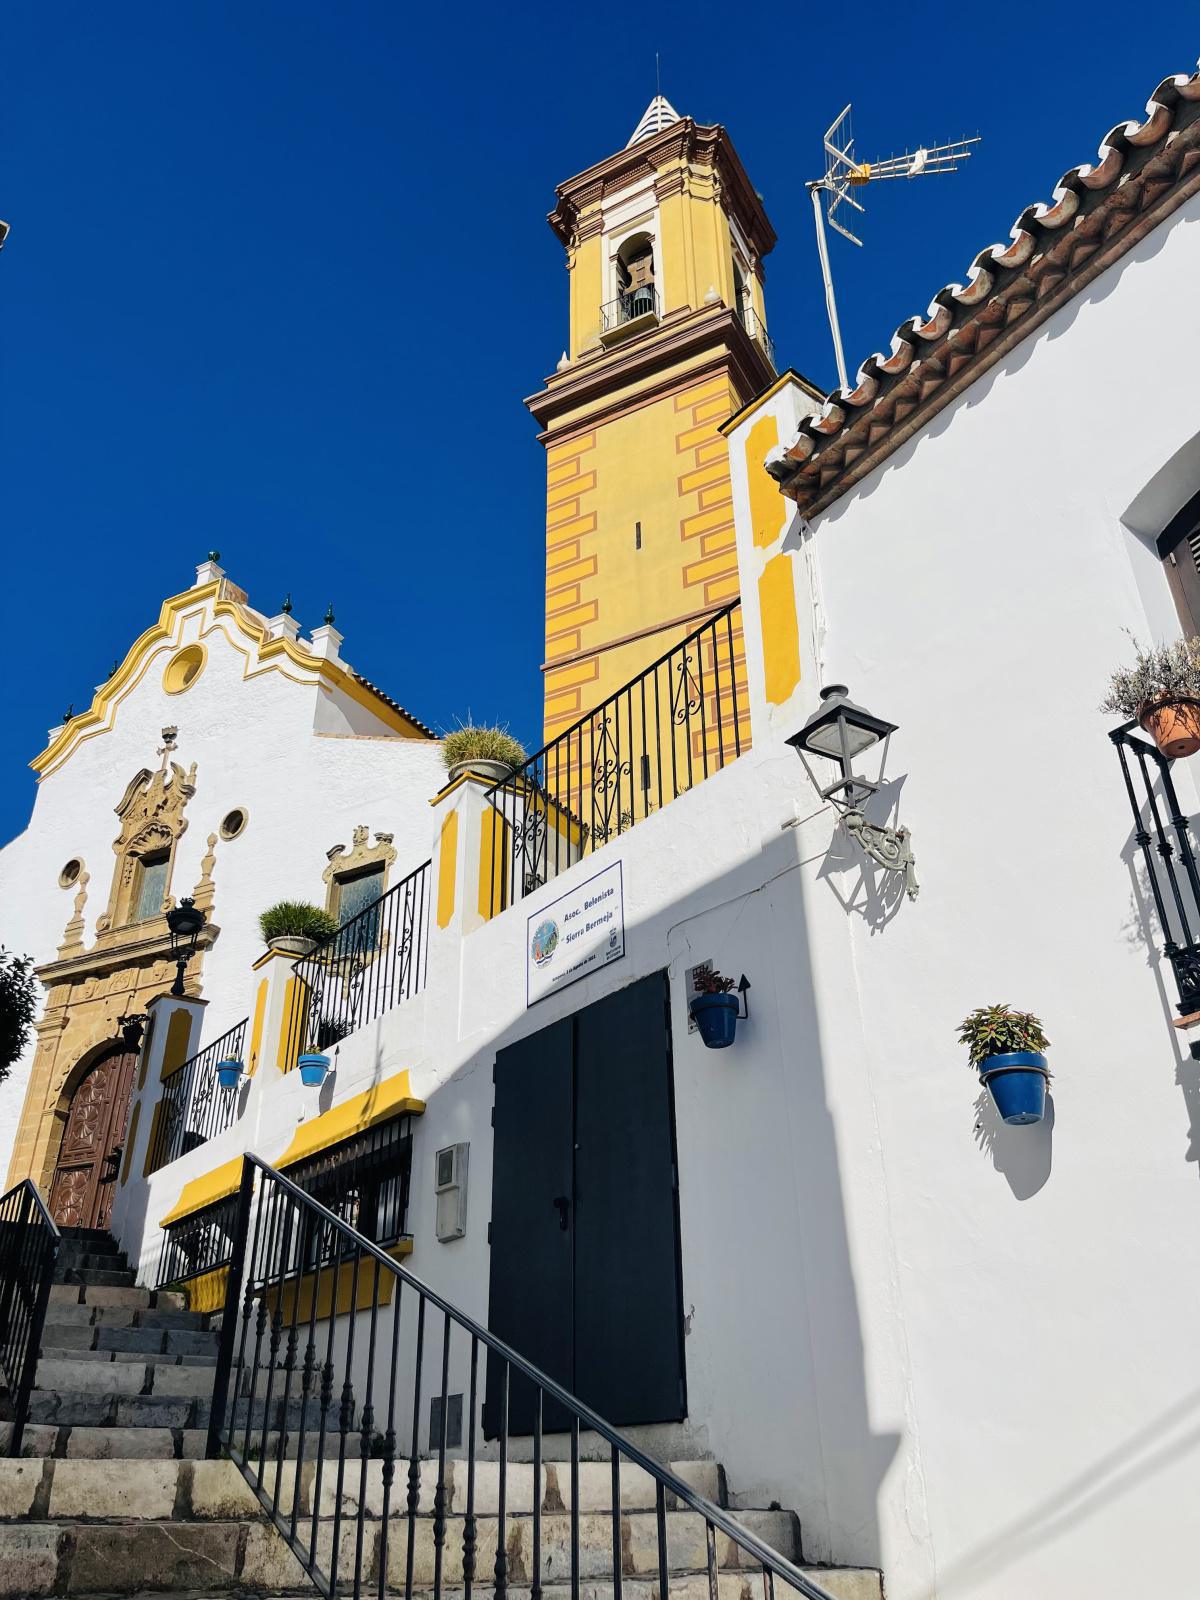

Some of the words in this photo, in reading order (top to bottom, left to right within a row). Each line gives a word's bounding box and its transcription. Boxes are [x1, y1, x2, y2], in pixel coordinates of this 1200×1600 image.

[564, 909, 581, 922] Asoc.
[584, 888, 614, 911] Belenista
[566, 929, 585, 944] Sierra
[585, 911, 613, 933] Bermeja
